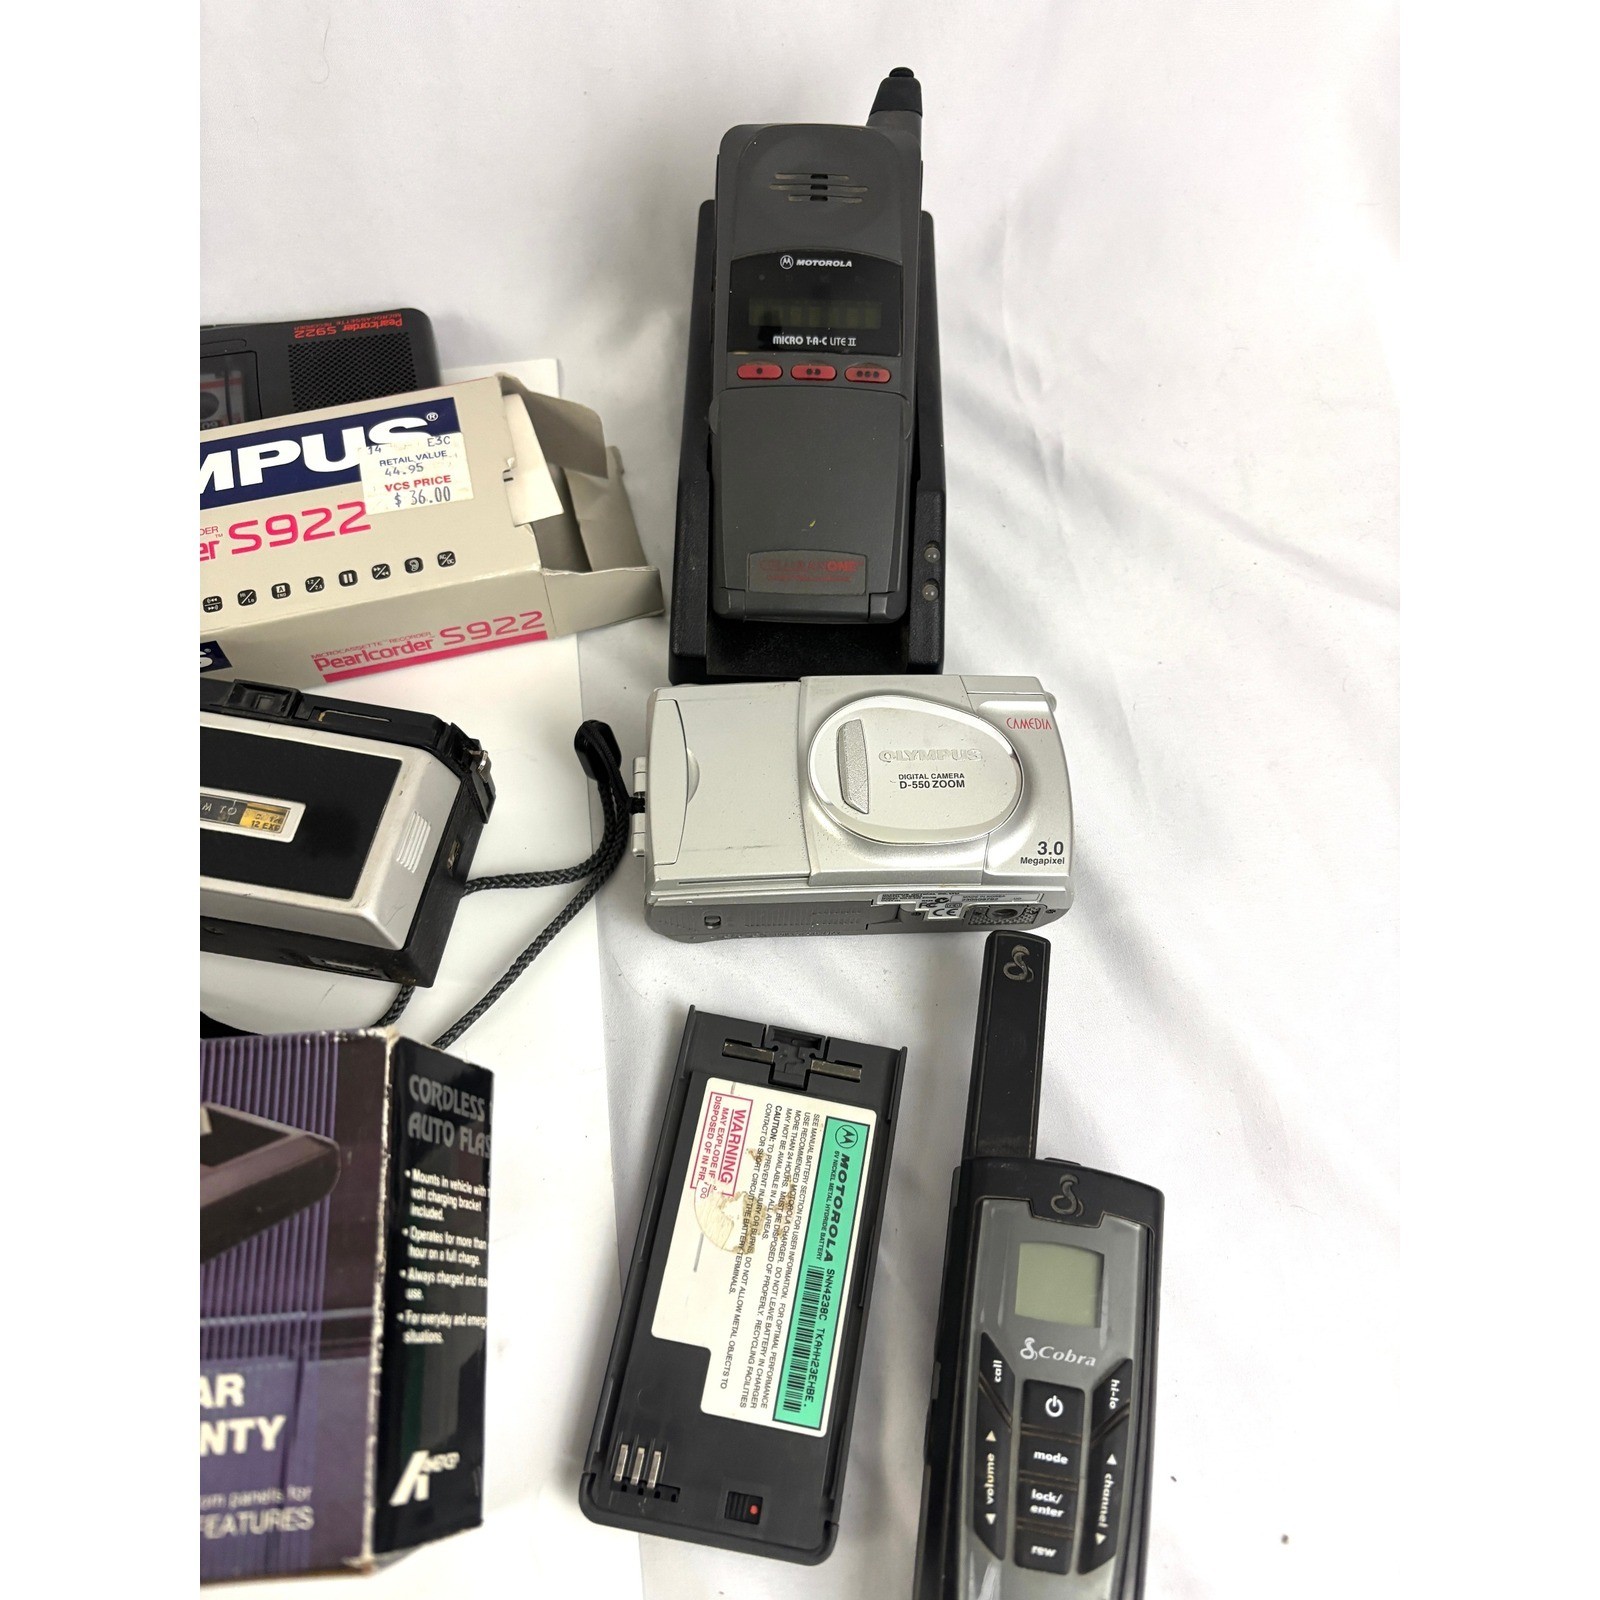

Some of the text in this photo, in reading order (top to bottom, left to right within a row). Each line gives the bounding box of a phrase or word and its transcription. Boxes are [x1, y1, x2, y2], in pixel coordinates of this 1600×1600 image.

[796, 259, 853, 268] MOTOROLA
[294, 318, 402, 339] Pearlcorder S922
[830, 337, 846, 347] LITE
[379, 450, 447, 467] RETAIL VALUE
[385, 463, 424, 477] 44.95
[385, 475, 452, 492] VCS PRICE
[394, 486, 451, 508] $ 36.00
[228, 501, 372, 555] S922
[314, 610, 546, 672] Pearlcorder S922
[1006, 717, 1052, 730] CAMEDIA
[878, 749, 983, 763] OLYMPUS
[899, 780, 965, 789] D-550 ZOOM
[1037, 841, 1064, 856] 3.0
[1020, 856, 1065, 866] Megapixel
[409, 1074, 486, 1122] CORDLESS
[706, 1095, 722, 1140] DISPOSED
[718, 1106, 729, 1126] MAY
[768, 1104, 782, 1142] CAUTION:
[408, 1111, 455, 1148] AUTO
[703, 1140, 712, 1154] OF
[709, 1126, 725, 1168] EXPLODE
[720, 1107, 746, 1184] WARNING
[766, 1142, 774, 1153] TO
[700, 1154, 709, 1164] IN
[759, 1153, 772, 1187] PREVENT
[411, 1168, 486, 1198] Mounts in vehicle with
[707, 1169, 716, 1179] IF
[761, 1107, 792, 1240] MAY NOT BE AVAILABLE IN ALL AREAS.
[410, 1186, 482, 1212] volt charging bracket
[728, 1102, 772, 1295] CONTACT OR SHORT CIRCUIT THE BATTERY TERMINALS.
[754, 1188, 765, 1215] INJURY
[815, 1150, 839, 1260] 6V NICKEL METAL HYDRIDE BATTERY
[823, 1153, 850, 1262] MOTOROLA
[410, 1202, 445, 1221] included.
[751, 1214, 760, 1227] OR
[409, 1225, 487, 1250] Operates for more than
[407, 1243, 427, 1259] hour
[428, 1249, 439, 1261] on
[445, 1248, 457, 1263] full
[458, 1251, 481, 1268] charge.
[739, 1109, 801, 1408] MORE THAN 24 HOURS. MUST BE DISPOSED OF PROPERLY. RECYCLING FACILITIES
[743, 1256, 752, 1268] DO
[749, 1111, 810, 1408] USE RECOMMENDED MOTOROLA CHARGER. DO NOT LEAVE BATTERY IN CHARGER
[760, 1113, 819, 1408] SEE MANUAL BATTERY SECTION FOR USER INFORMATION. FOR OPTIMAL PERFORMANCE
[406, 1266, 436, 1286] Always
[436, 1270, 464, 1288] charged
[465, 1274, 477, 1287] and
[740, 1269, 749, 1285] NOT
[405, 1288, 424, 1301] use.
[734, 1286, 746, 1313] ALLOW
[404, 1309, 419, 1325] For
[420, 1312, 452, 1329] everyday
[453, 1313, 467, 1326] and
[729, 1313, 740, 1339] METAL
[402, 1328, 445, 1344] situations.
[722, 1339, 735, 1377] OBJECTS
[1039, 1346, 1097, 1367] Cobra
[994, 1359, 1003, 1383] call
[719, 1377, 728, 1389] TO
[1109, 1379, 1120, 1409] hi-lo
[1033, 1450, 1069, 1465] mode
[986, 1453, 995, 1505] volume
[1031, 1488, 1063, 1504] lock/
[1098, 1473, 1115, 1528] channel
[1030, 1503, 1065, 1518] enter
[1031, 1545, 1057, 1558] rew
